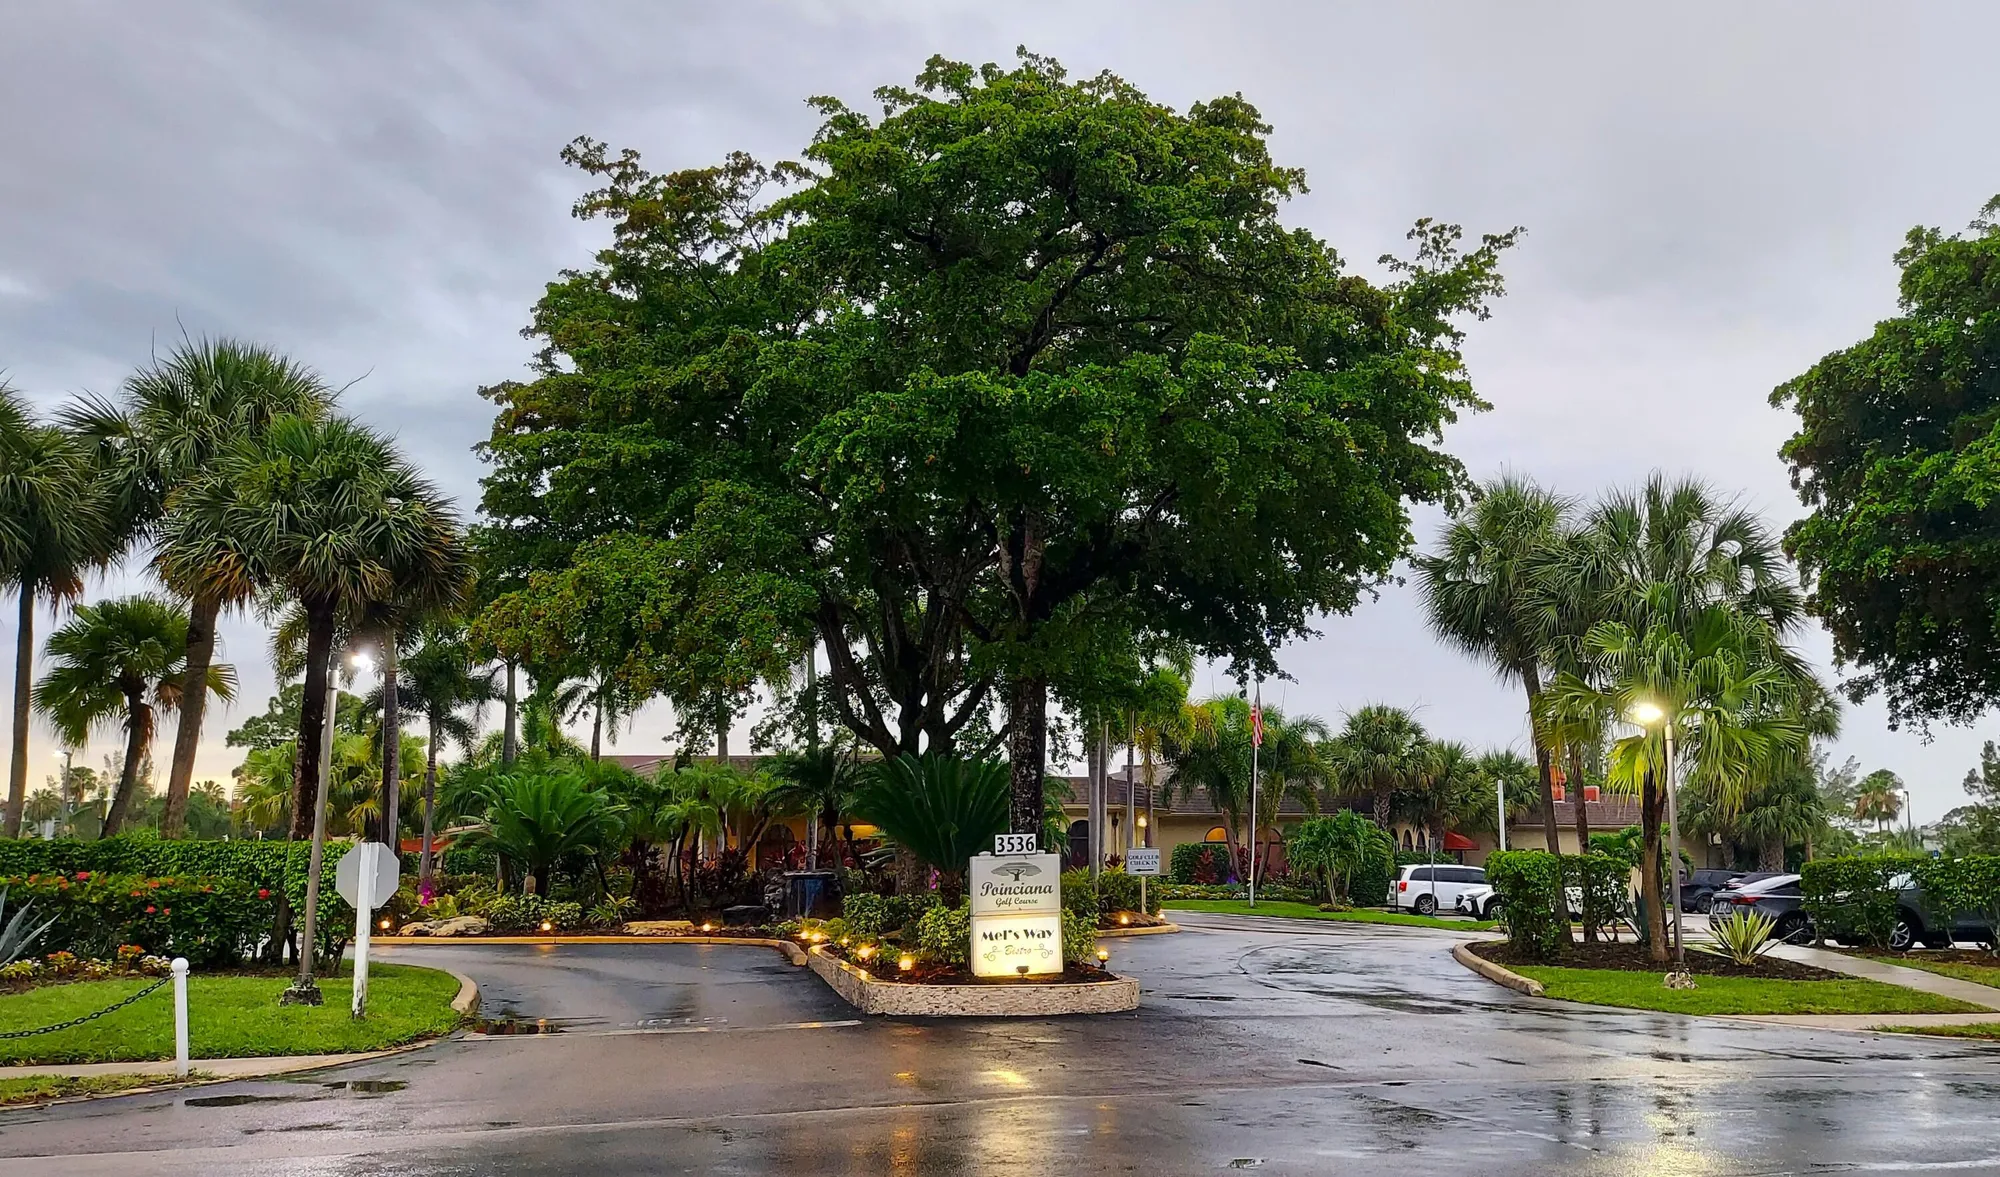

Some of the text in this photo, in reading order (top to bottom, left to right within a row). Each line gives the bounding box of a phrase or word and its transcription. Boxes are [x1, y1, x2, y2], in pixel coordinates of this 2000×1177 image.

[997, 836, 1035, 853] 3536
[980, 881, 1054, 897] Poinciana
[995, 897, 1039, 908] Golf Course
[981, 928, 1055, 942] Mel's Way
[1004, 945, 1032, 956] Bistro
